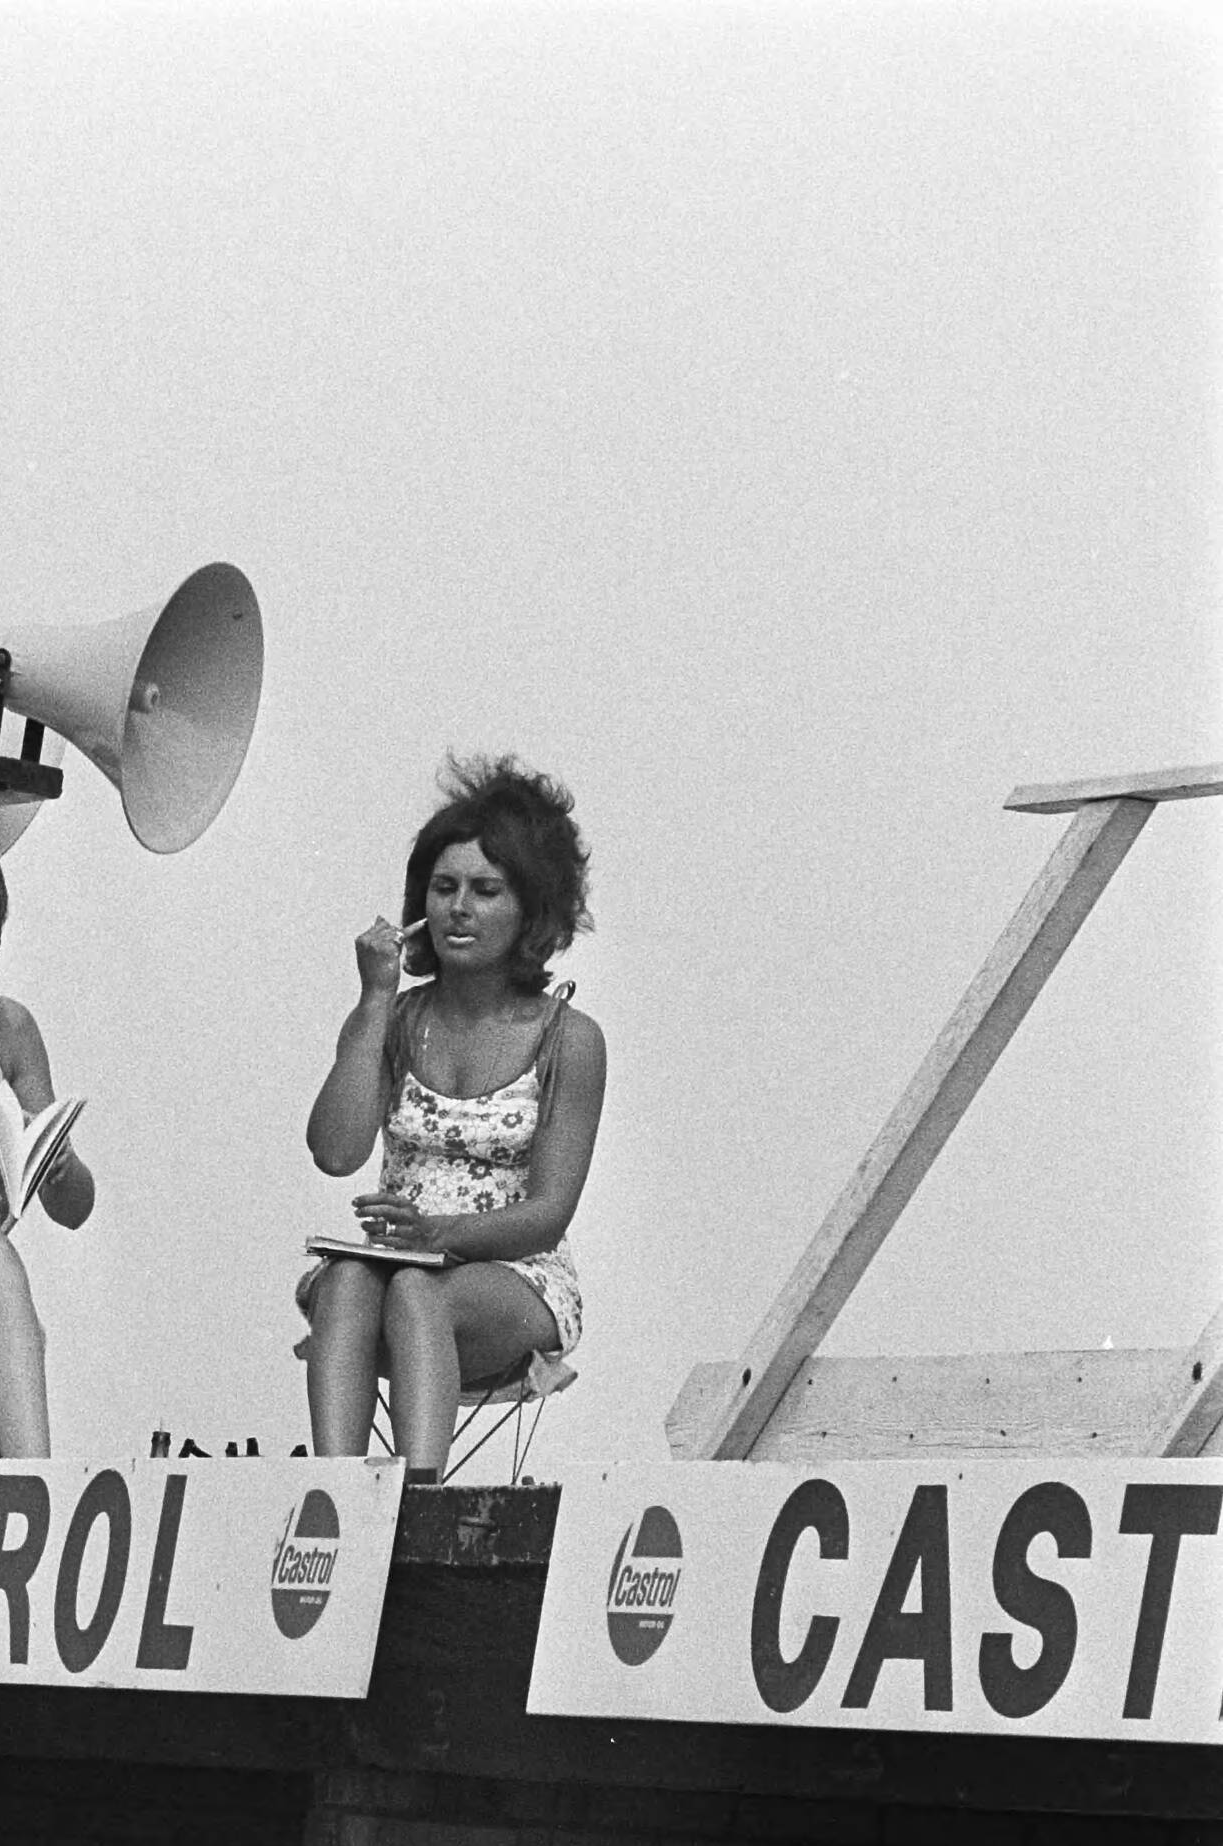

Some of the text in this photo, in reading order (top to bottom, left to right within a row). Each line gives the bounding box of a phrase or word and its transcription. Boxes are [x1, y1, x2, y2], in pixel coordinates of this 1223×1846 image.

[278, 1544, 339, 1584] Castrol
[614, 1564, 682, 1608] Castrol
[751, 1479, 1223, 1720] CAST
